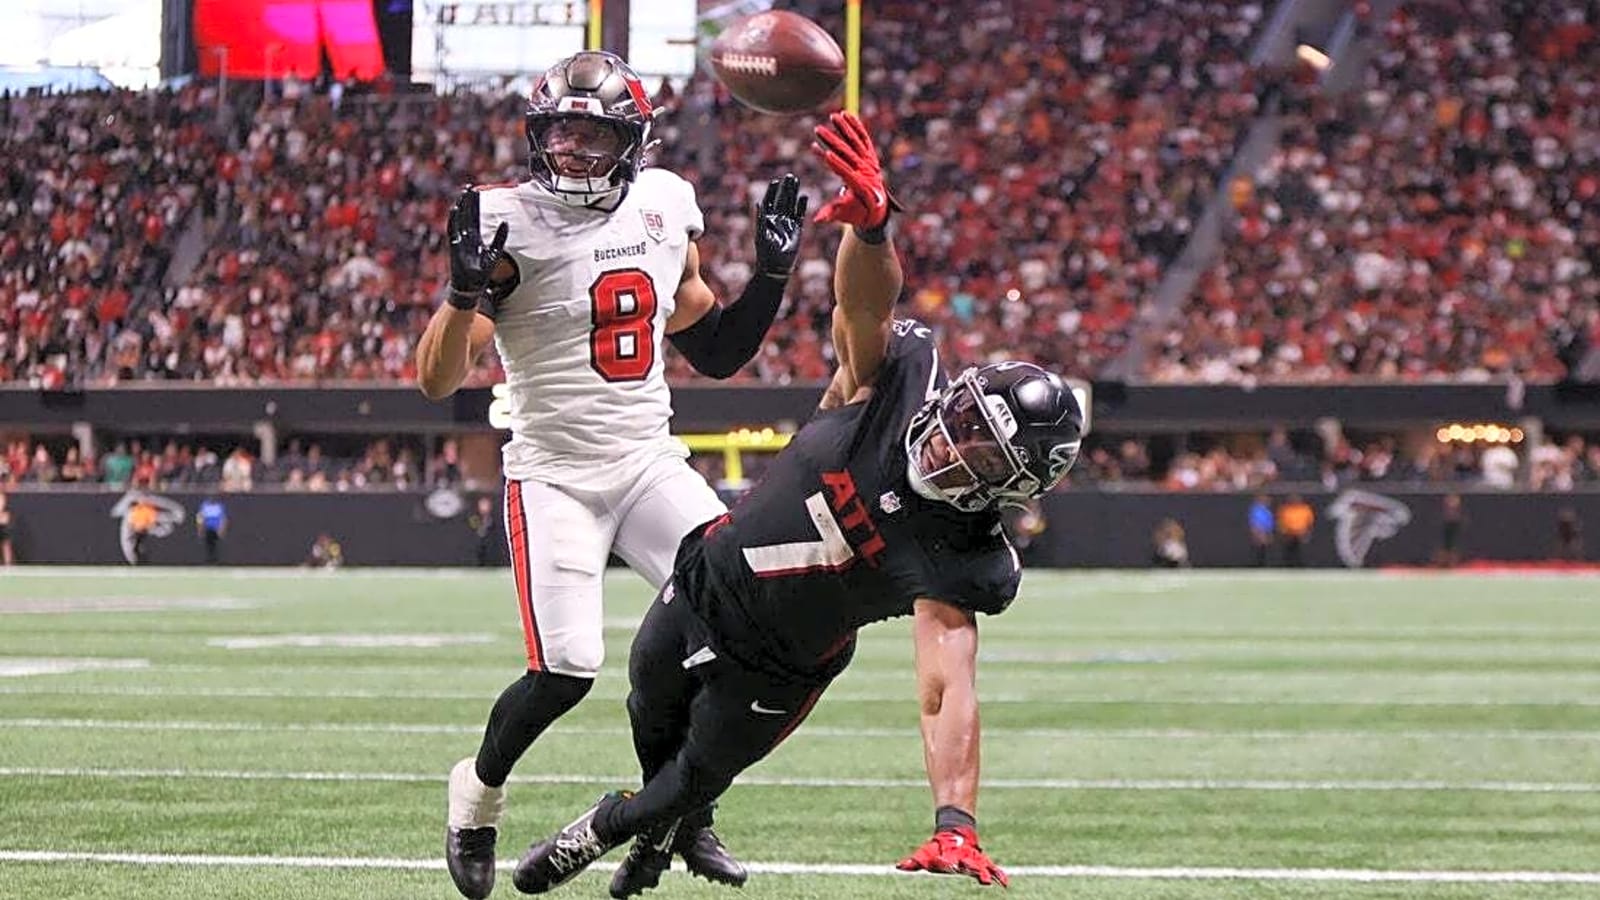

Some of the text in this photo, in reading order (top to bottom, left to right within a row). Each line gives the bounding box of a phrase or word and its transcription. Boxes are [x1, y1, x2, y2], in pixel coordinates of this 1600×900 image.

[594, 241, 647, 262] BUCCANEERS
[644, 213, 664, 229] 50
[589, 267, 658, 383] 8
[742, 491, 855, 579] 7
[820, 468, 886, 568] ATL
